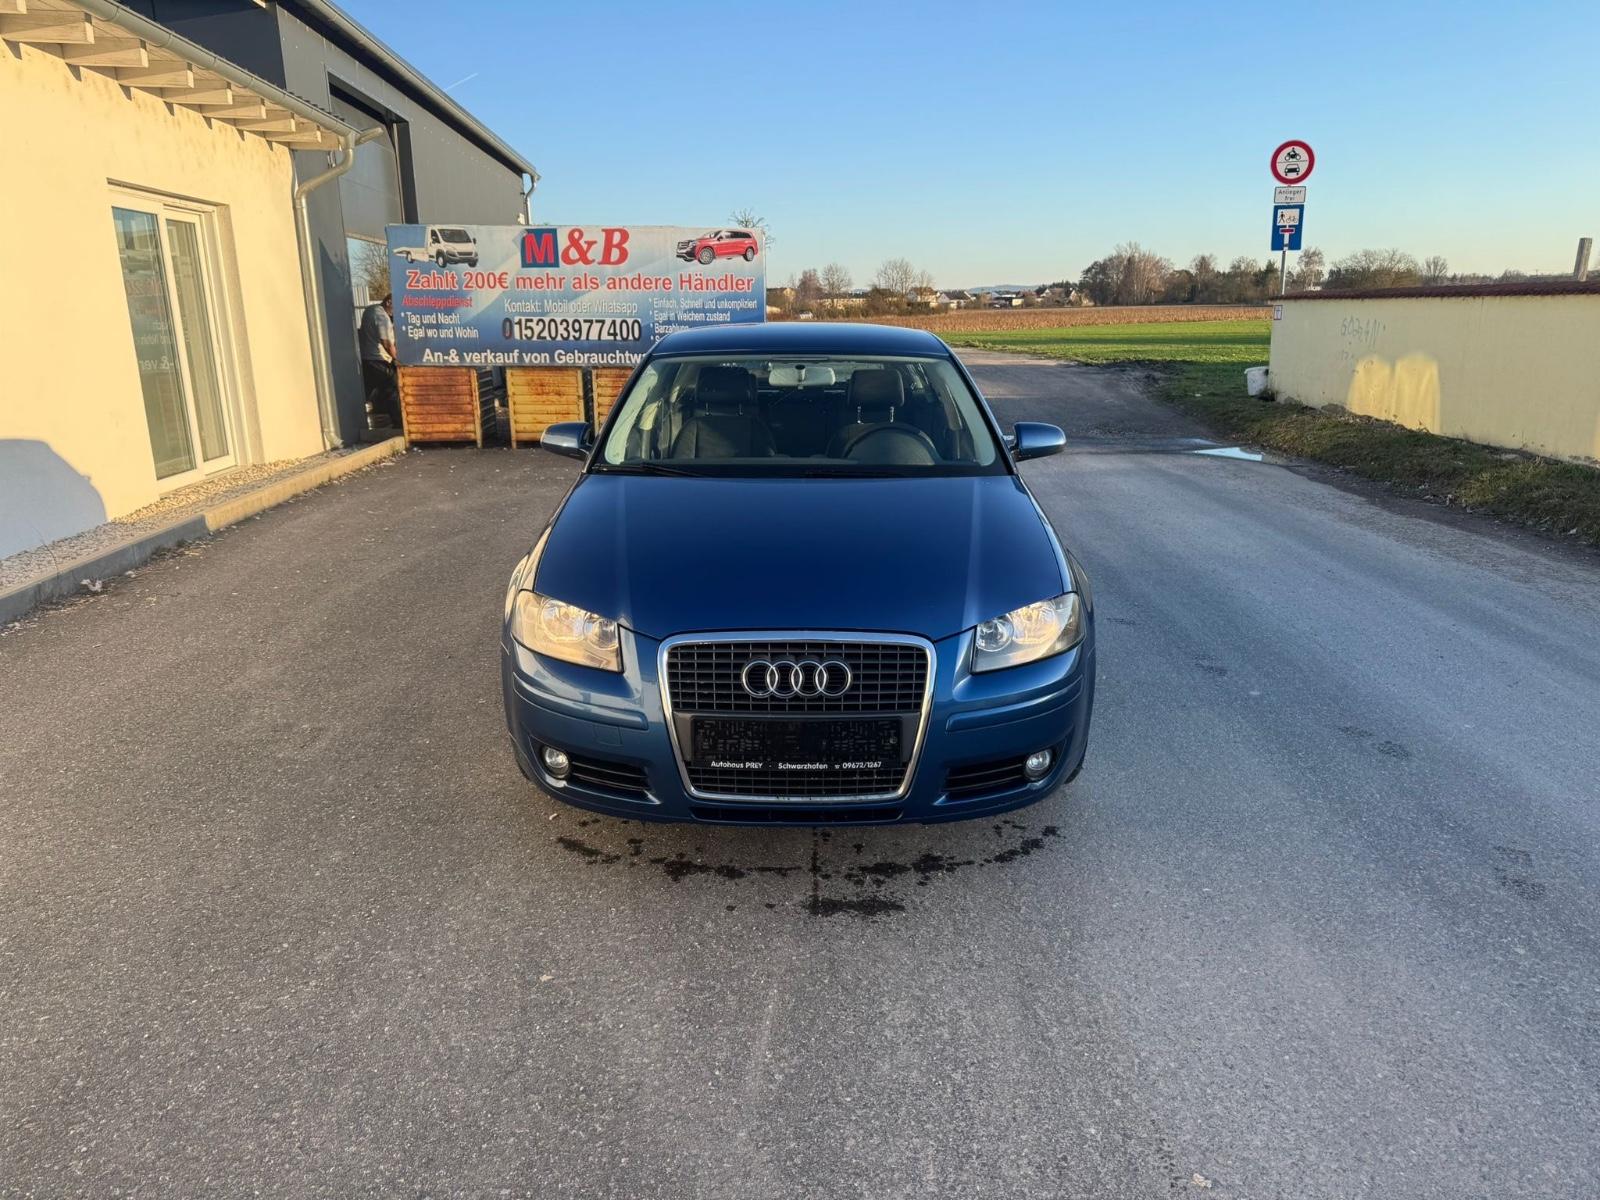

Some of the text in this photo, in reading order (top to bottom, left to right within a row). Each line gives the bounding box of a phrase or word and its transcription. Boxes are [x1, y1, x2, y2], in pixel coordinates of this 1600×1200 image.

[523, 227, 630, 266] M&B
[406, 270, 754, 291] Zahlt 200€ mehr als andere Händler
[401, 295, 473, 309] Abschleppdienst
[504, 299, 638, 316] Kontakt: Mobil oder Whatsapp
[680, 298, 703, 308] Schnell
[704, 299, 716, 308] und
[717, 299, 757, 310] unkompliziert
[406, 312, 460, 326] Tag und Nacht
[654, 311, 731, 322] Egal in Welchem zustand
[407, 327, 479, 340] Egal wo und Wohin
[502, 317, 642, 342] 015203977400
[422, 348, 645, 364] An-& verkauf von Gebrauchtw
[710, 760, 882, 770] Autohaus PREY Schwarzhofen 09672/1267
